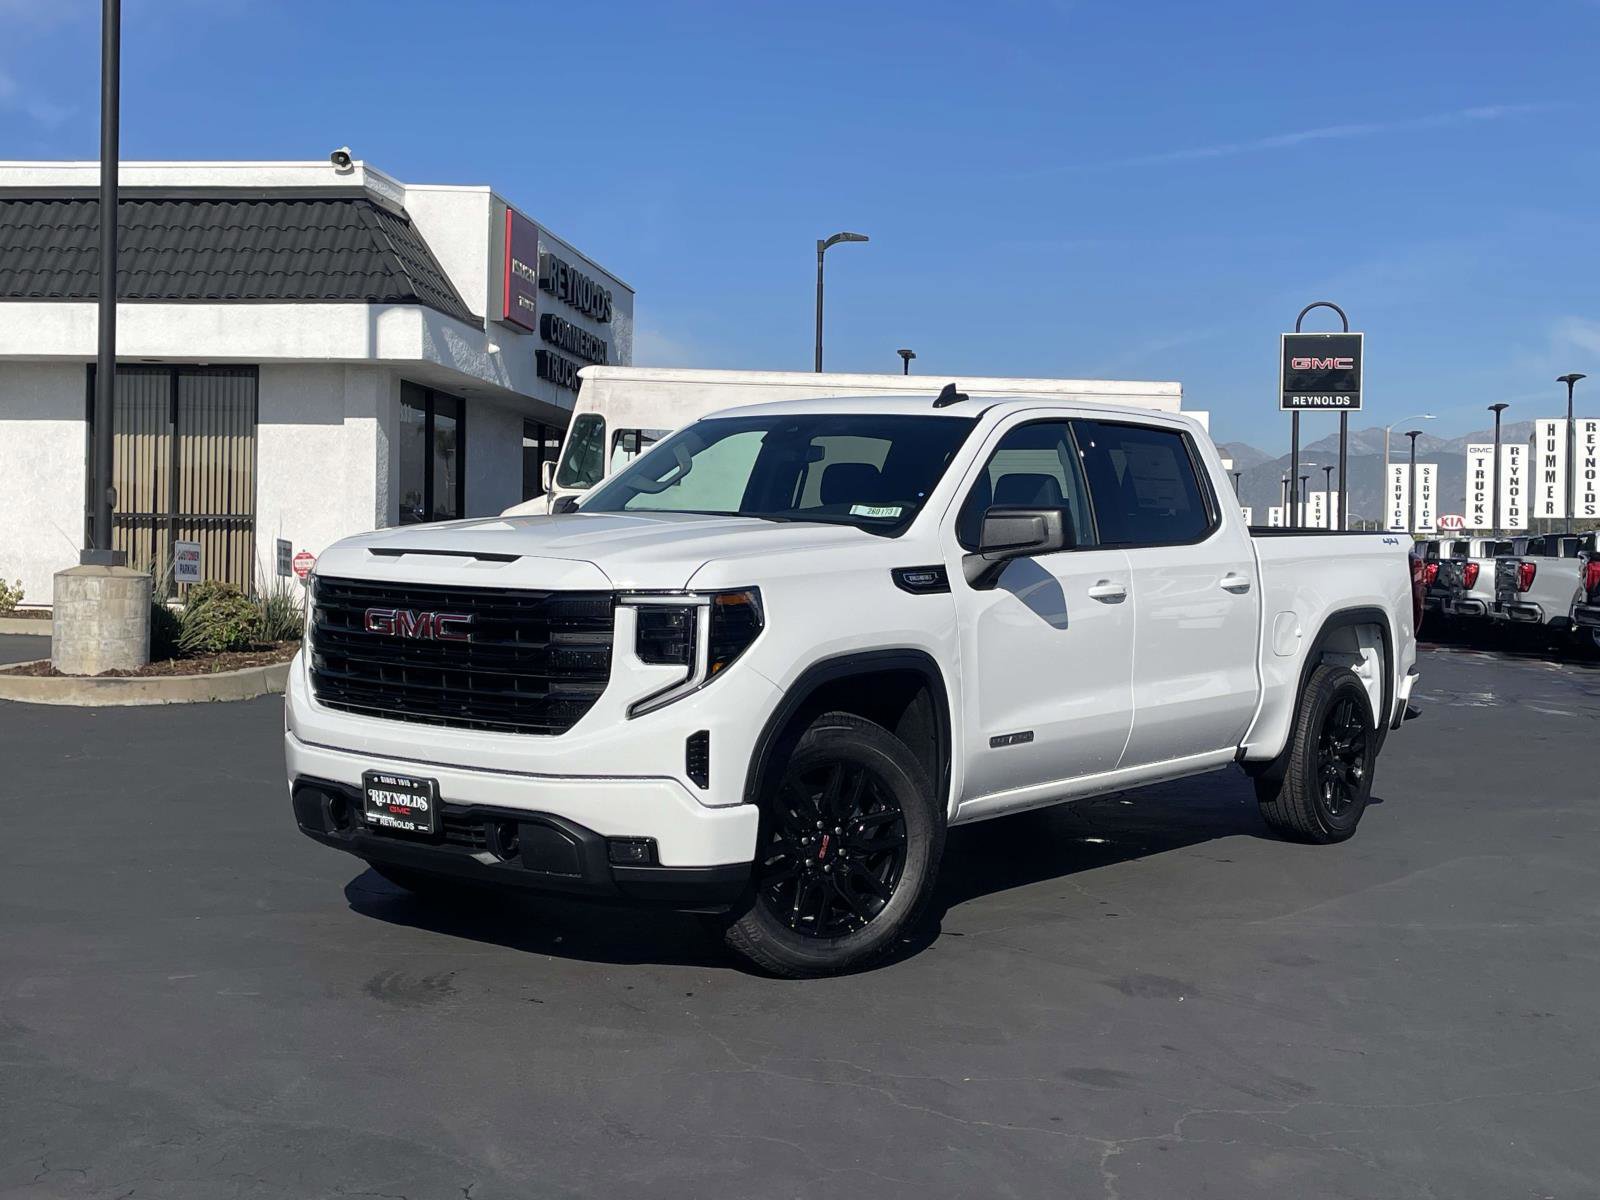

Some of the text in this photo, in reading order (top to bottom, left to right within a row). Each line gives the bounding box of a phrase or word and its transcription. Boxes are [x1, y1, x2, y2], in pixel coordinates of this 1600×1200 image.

[546, 252, 613, 323] REYNOLDS
[547, 313, 608, 365] COMMERCIAL
[545, 350, 579, 391] TRUCK
[1291, 357, 1354, 370] GMC
[1292, 395, 1351, 405] REYNOLDS
[1509, 446, 1519, 527] REYNOLDS
[1545, 423, 1556, 515] HUMMER
[1584, 422, 1597, 516] REYNOLDS
[1394, 467, 1402, 526] SERVICE
[1422, 467, 1430, 526] SERVICE
[1474, 458, 1485, 525] TRUCKS
[1441, 517, 1464, 527] KIA
[180, 563, 197, 575] PARKING
[365, 608, 472, 642] GMC
[368, 789, 427, 811] REYNOLDS
[389, 806, 410, 814] GMC
[380, 818, 414, 830] REYNOLDS
